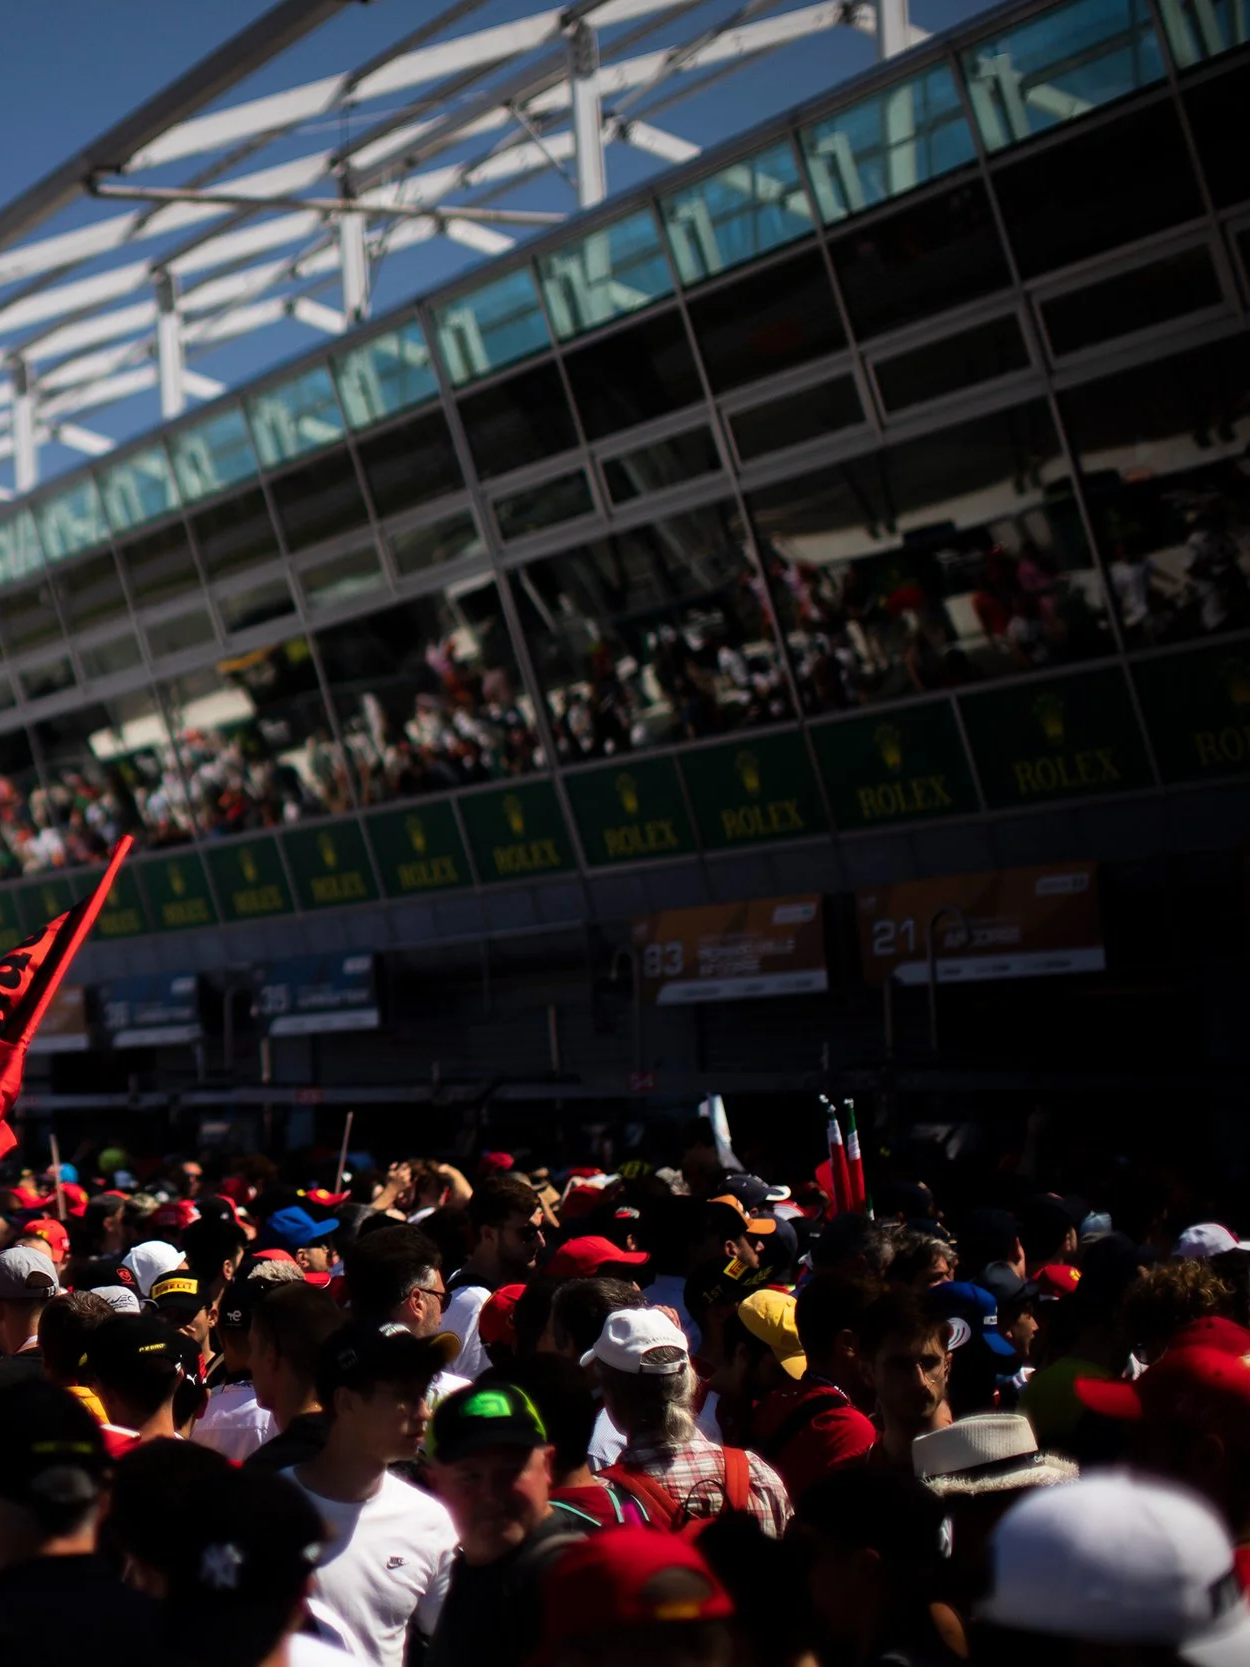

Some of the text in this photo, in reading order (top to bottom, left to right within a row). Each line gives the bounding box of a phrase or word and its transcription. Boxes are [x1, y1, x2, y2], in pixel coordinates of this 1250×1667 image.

[1010, 746, 1123, 796] ROLEX
[855, 772, 954, 821] ROLEX
[602, 819, 680, 857] ROLEX
[720, 798, 806, 841] ROLEX
[492, 838, 562, 875] ROLEX
[872, 916, 916, 958] 21
[642, 940, 684, 979] 83
[155, 1281, 193, 1296] PIRELLI
